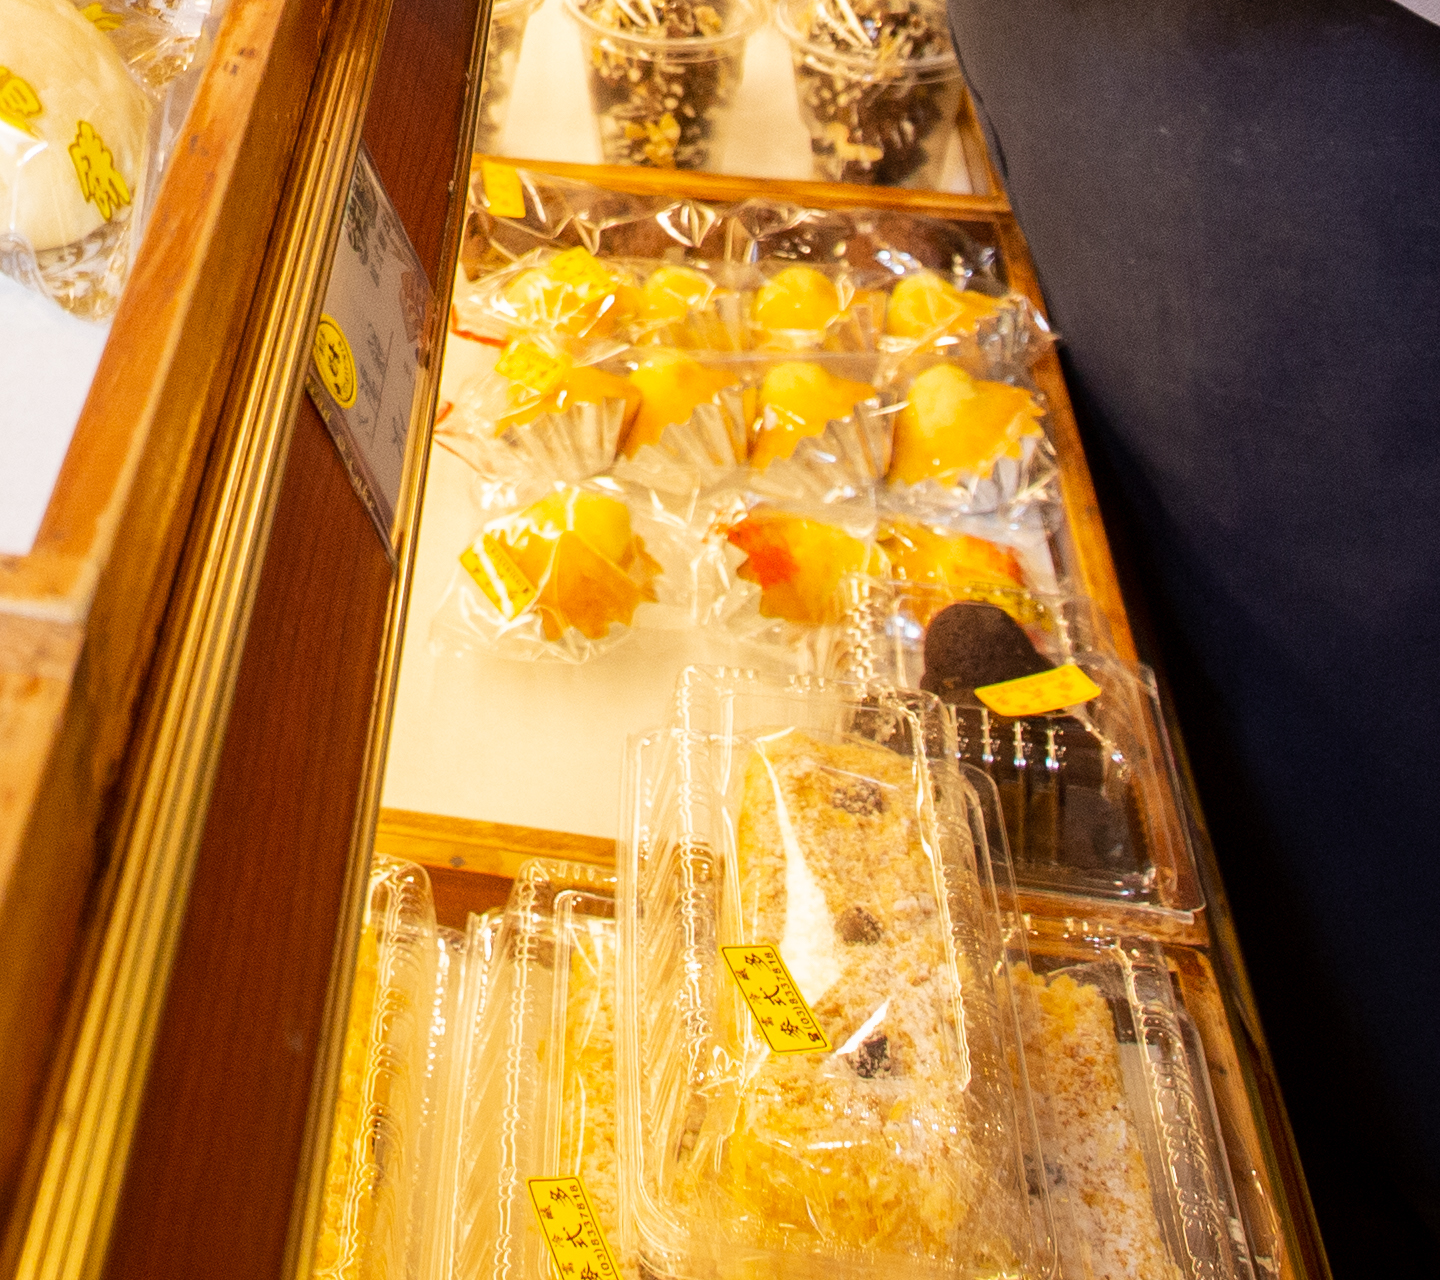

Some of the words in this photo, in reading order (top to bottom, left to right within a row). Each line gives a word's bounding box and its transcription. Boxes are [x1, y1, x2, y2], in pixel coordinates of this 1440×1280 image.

[743, 952, 807, 1040] 麥式多
[764, 951, 814, 1031] (03)8337818
[569, 1184, 614, 1277] (03)8337818
